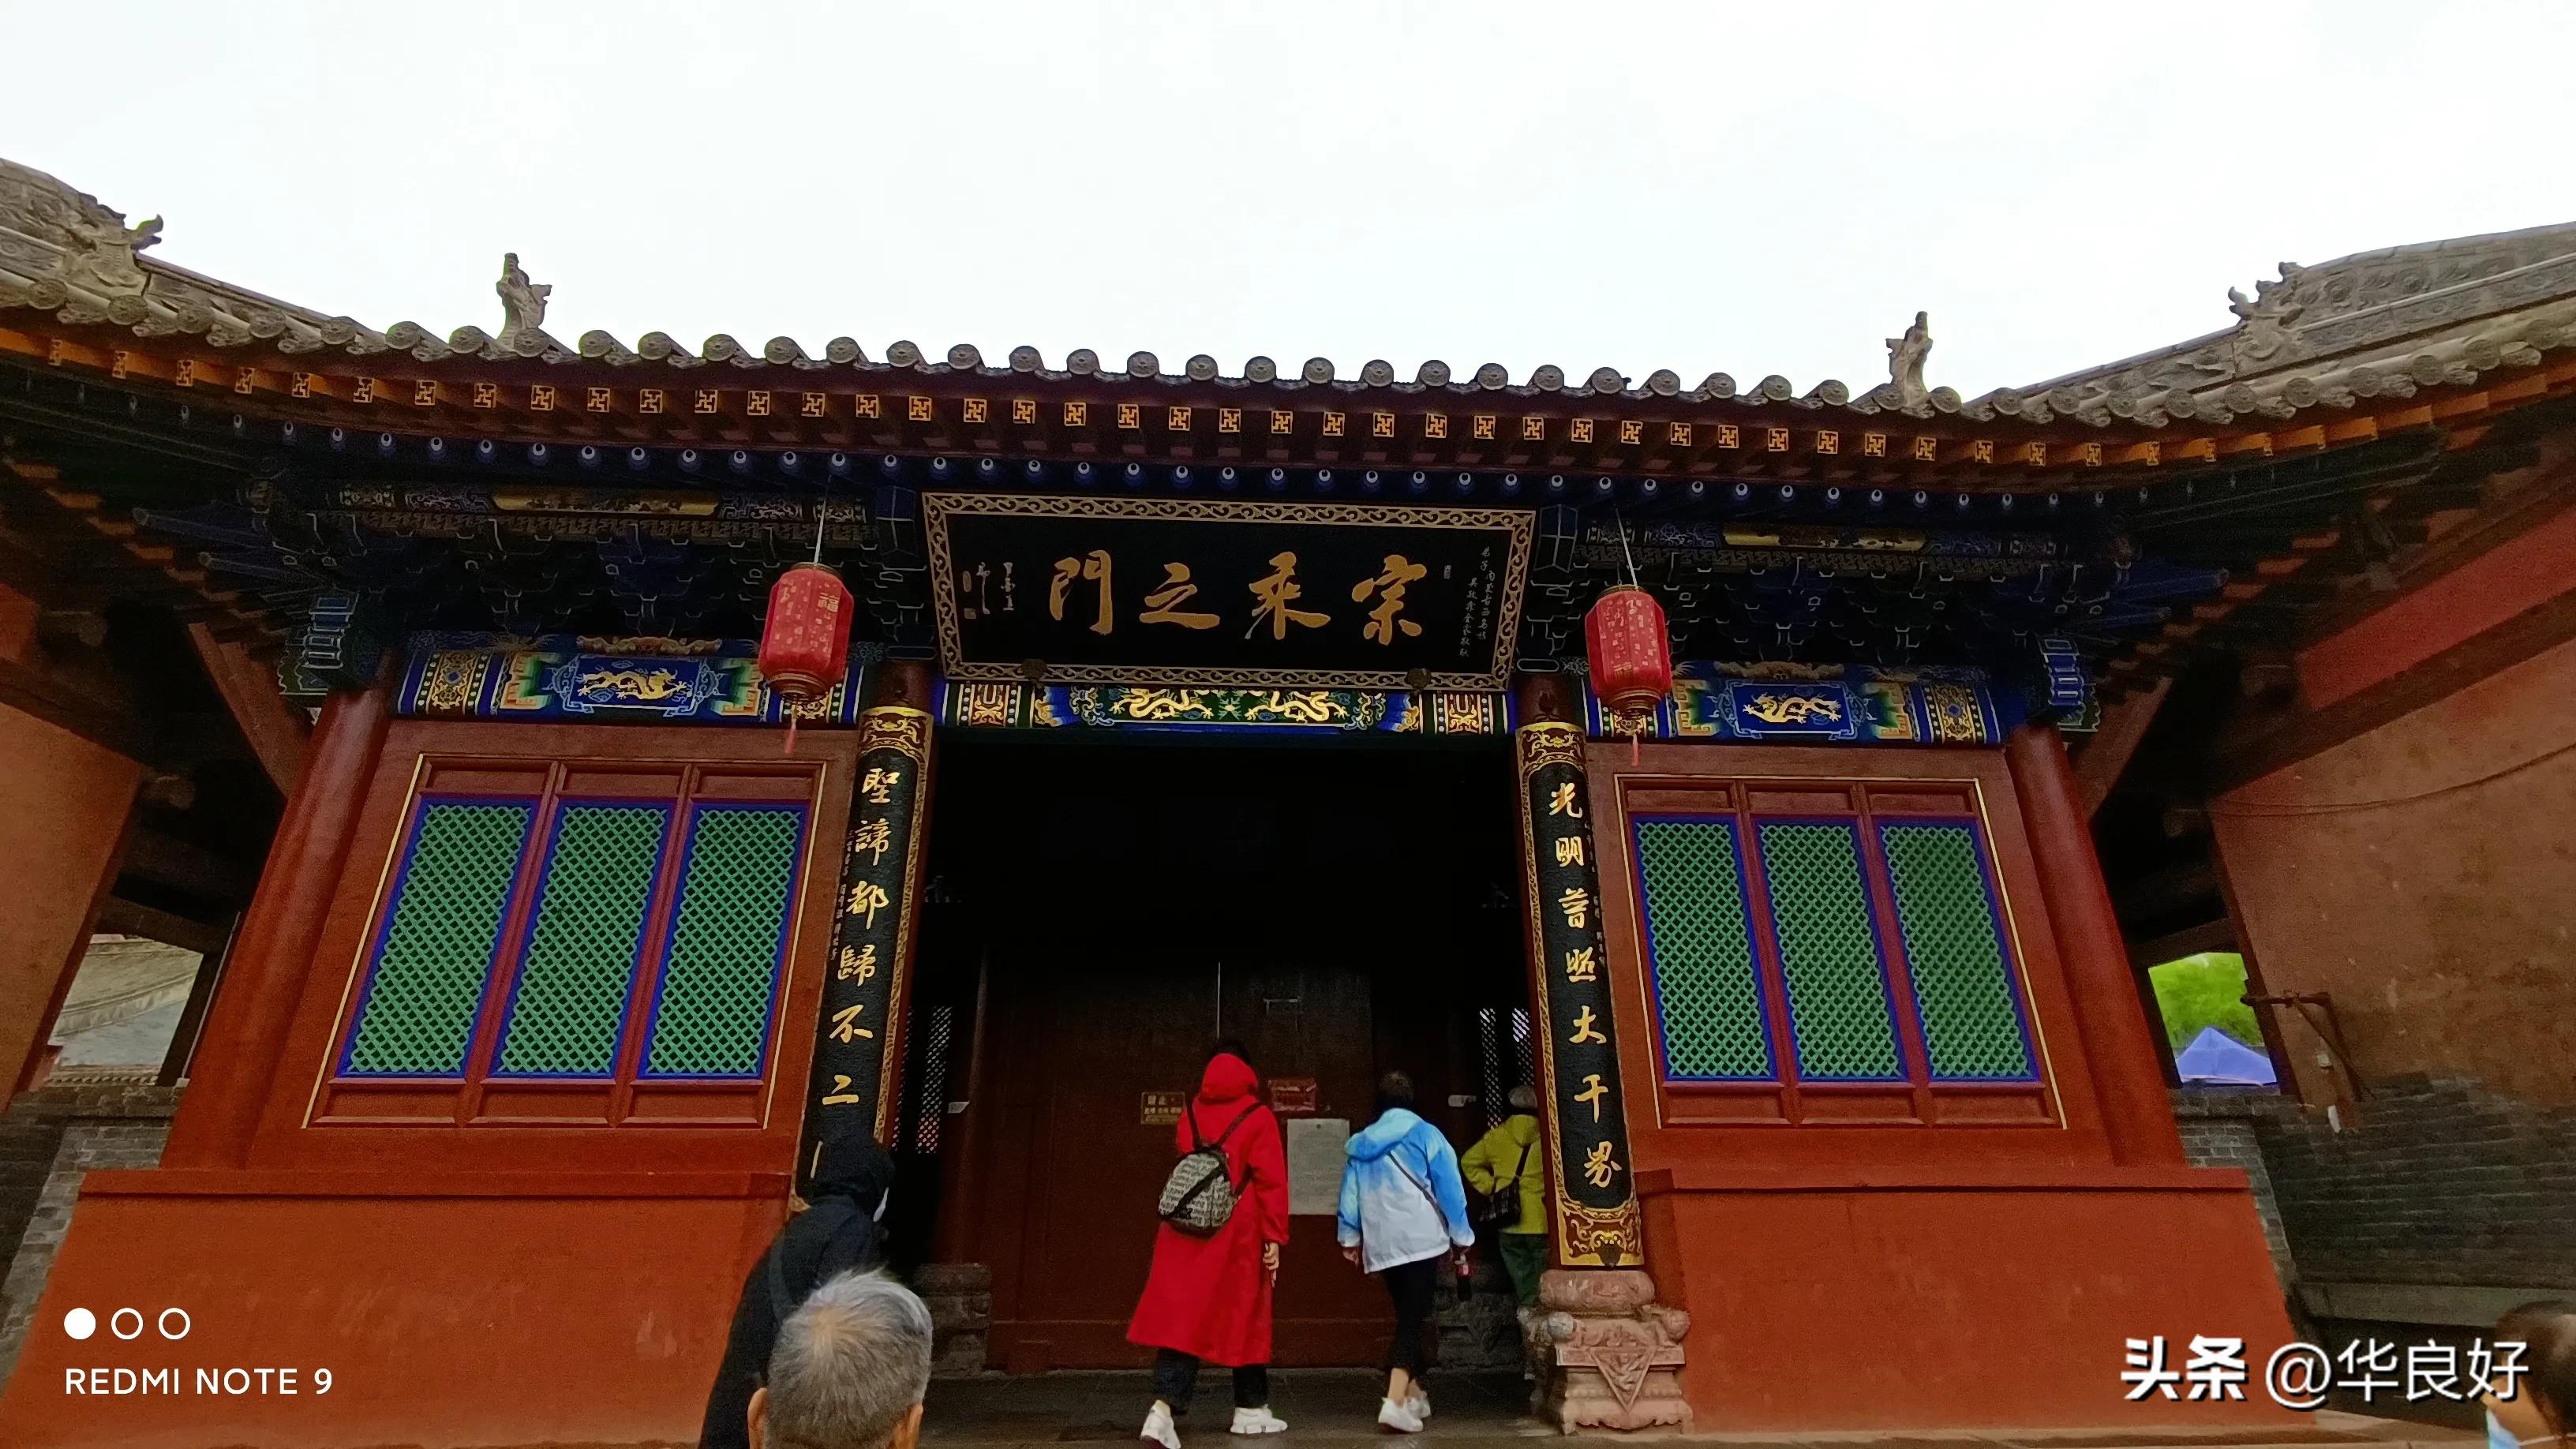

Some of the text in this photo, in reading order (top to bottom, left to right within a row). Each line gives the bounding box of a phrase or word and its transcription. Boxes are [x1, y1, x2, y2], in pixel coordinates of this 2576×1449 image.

[810, 766, 900, 1178] 聖諦都歸不二
